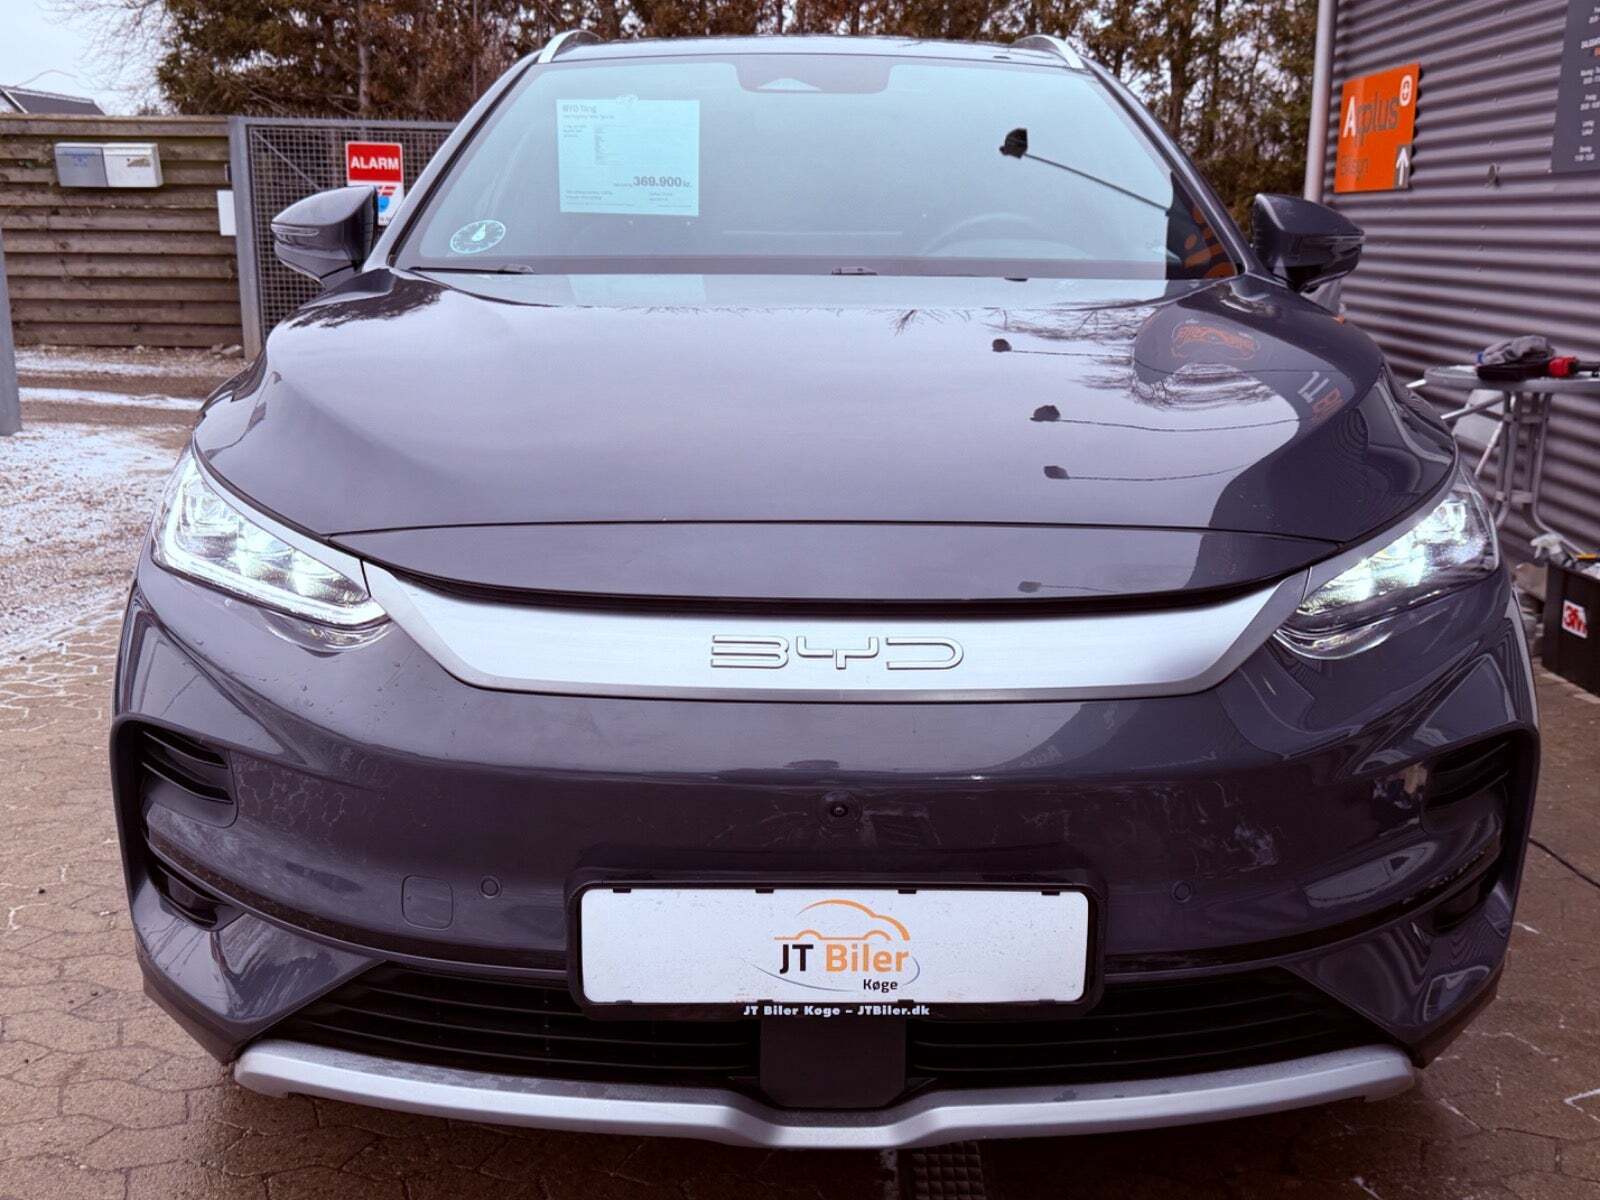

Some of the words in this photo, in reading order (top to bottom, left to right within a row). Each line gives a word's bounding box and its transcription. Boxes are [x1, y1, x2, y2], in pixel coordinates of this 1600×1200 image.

[350, 156, 400, 171] ALARM
[633, 175, 682, 188] 369.900
[711, 635, 964, 670] BYD
[779, 943, 814, 975] JT
[826, 943, 910, 973] Biler
[863, 978, 898, 993] Køge
[743, 1005, 758, 1016] JT
[763, 1005, 799, 1016] Biler
[857, 1005, 930, 1016] JTBiler.dk
